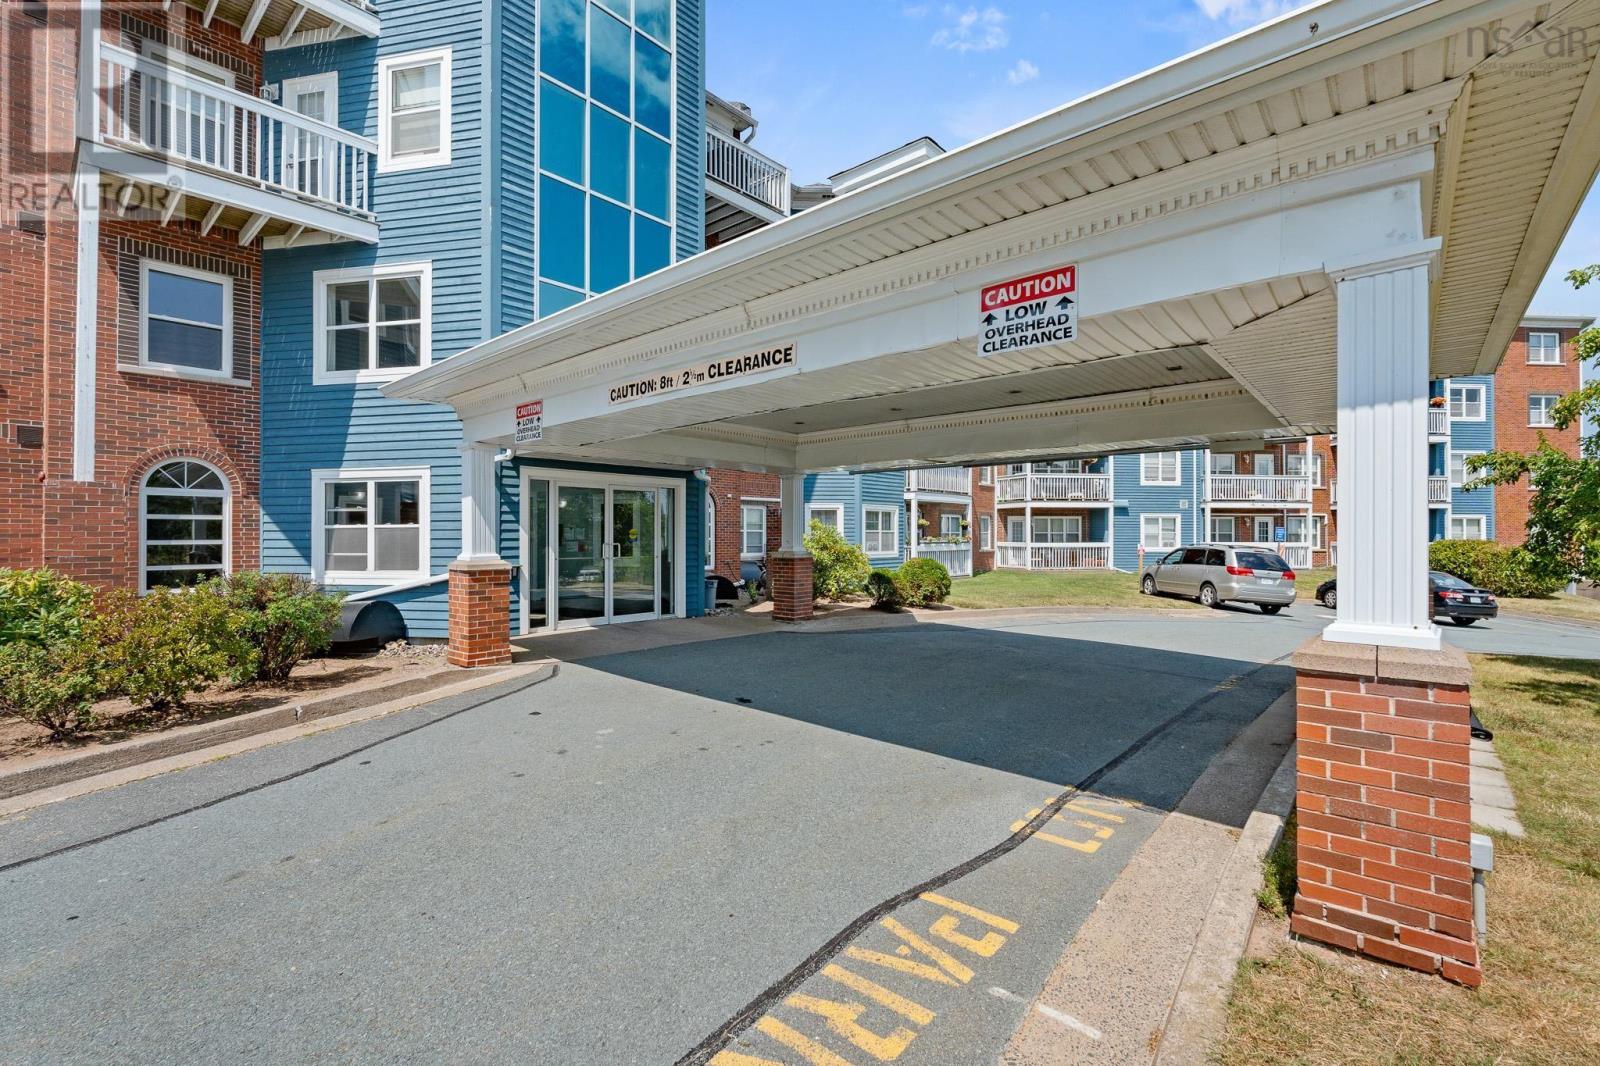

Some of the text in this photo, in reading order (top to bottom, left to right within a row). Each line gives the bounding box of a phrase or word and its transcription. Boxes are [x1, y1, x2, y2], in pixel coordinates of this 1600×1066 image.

[985, 272, 1071, 306] CAUTION
[1005, 301, 1047, 322] LOW
[985, 313, 1070, 340] OVERHEAD
[982, 326, 1073, 353] CLEARANCE
[610, 378, 657, 402] CAUTION:
[659, 375, 674, 390] 8ft
[708, 346, 793, 379] CLEARANCE
[517, 403, 541, 417] CAUTION
[516, 424, 541, 435] OVERHEAD
[522, 417, 535, 427] LOW
[516, 431, 541, 442] CLEARANCE
